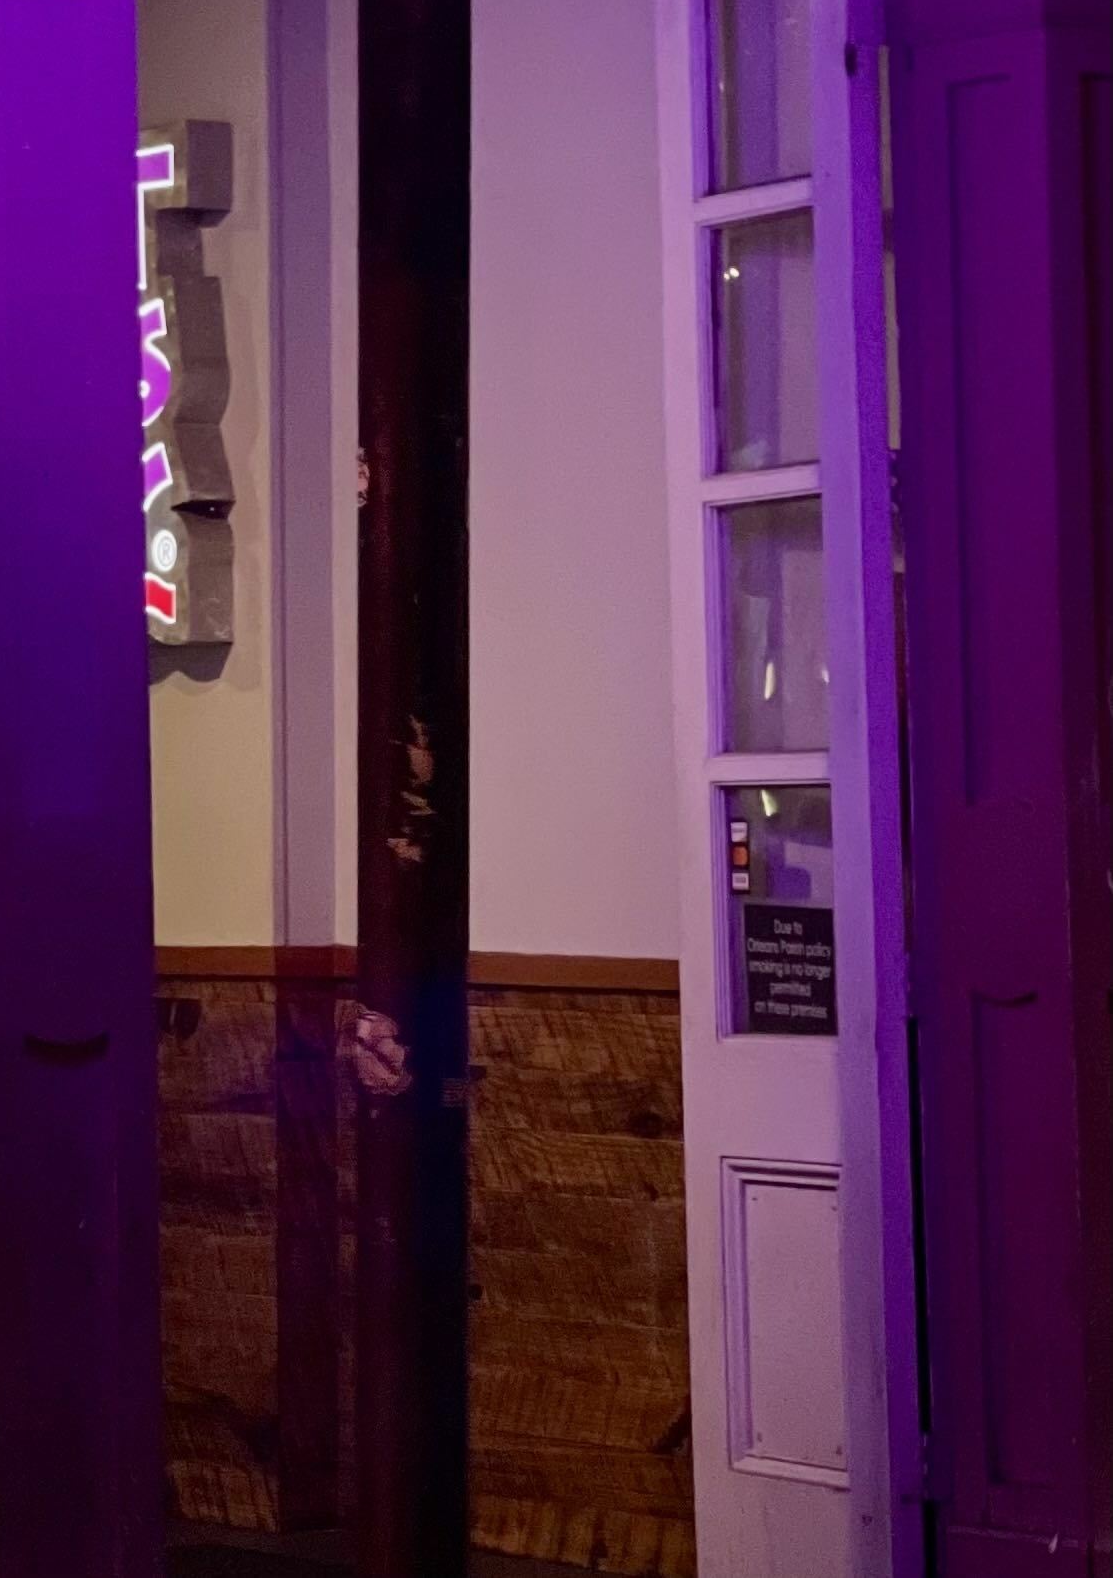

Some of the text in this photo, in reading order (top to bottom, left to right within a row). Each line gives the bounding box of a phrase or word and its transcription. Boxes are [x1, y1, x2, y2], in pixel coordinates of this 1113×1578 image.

[773, 918, 803, 935] Due to
[805, 942, 831, 960] policy
[749, 960, 784, 978] smoking
[791, 963, 803, 976] no
[804, 963, 831, 981] longer
[769, 981, 812, 998] permitted
[754, 1001, 766, 1014] on
[790, 1004, 828, 1019] premises
